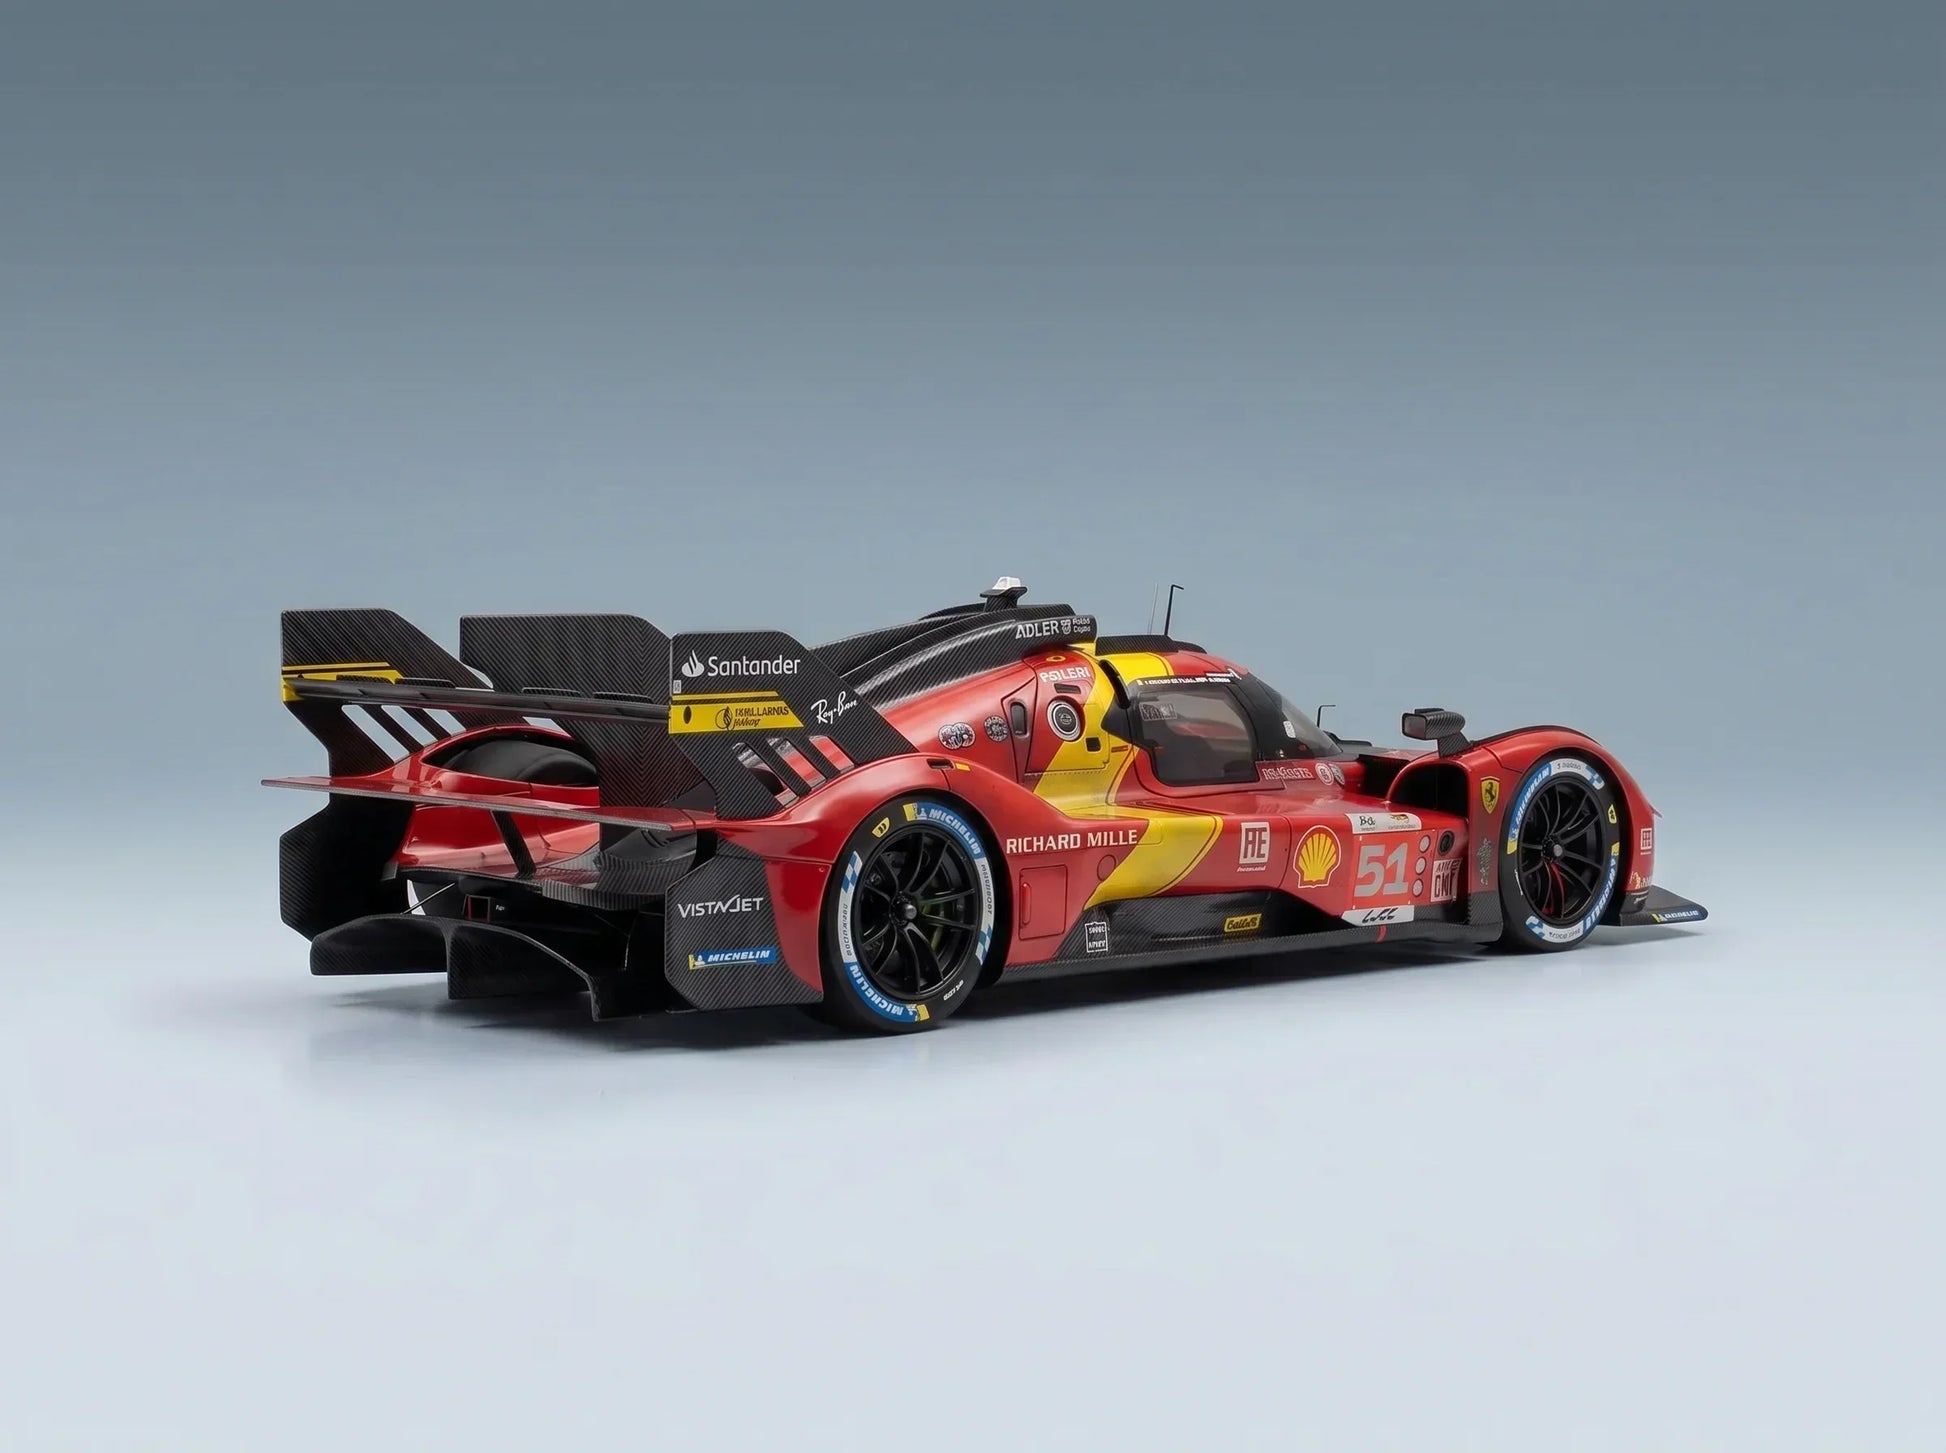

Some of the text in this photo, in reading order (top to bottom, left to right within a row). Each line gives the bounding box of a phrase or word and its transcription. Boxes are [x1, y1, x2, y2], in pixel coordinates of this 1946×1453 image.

[1015, 620, 1060, 639] ADLER
[707, 655, 801, 677] Santander
[929, 808, 982, 855] MICHELIN
[1006, 829, 1138, 854] RICHARD MILLE
[1353, 842, 1409, 897] 51
[707, 950, 771, 963] MICHELIN
[850, 964, 904, 1016] MICHELIN
